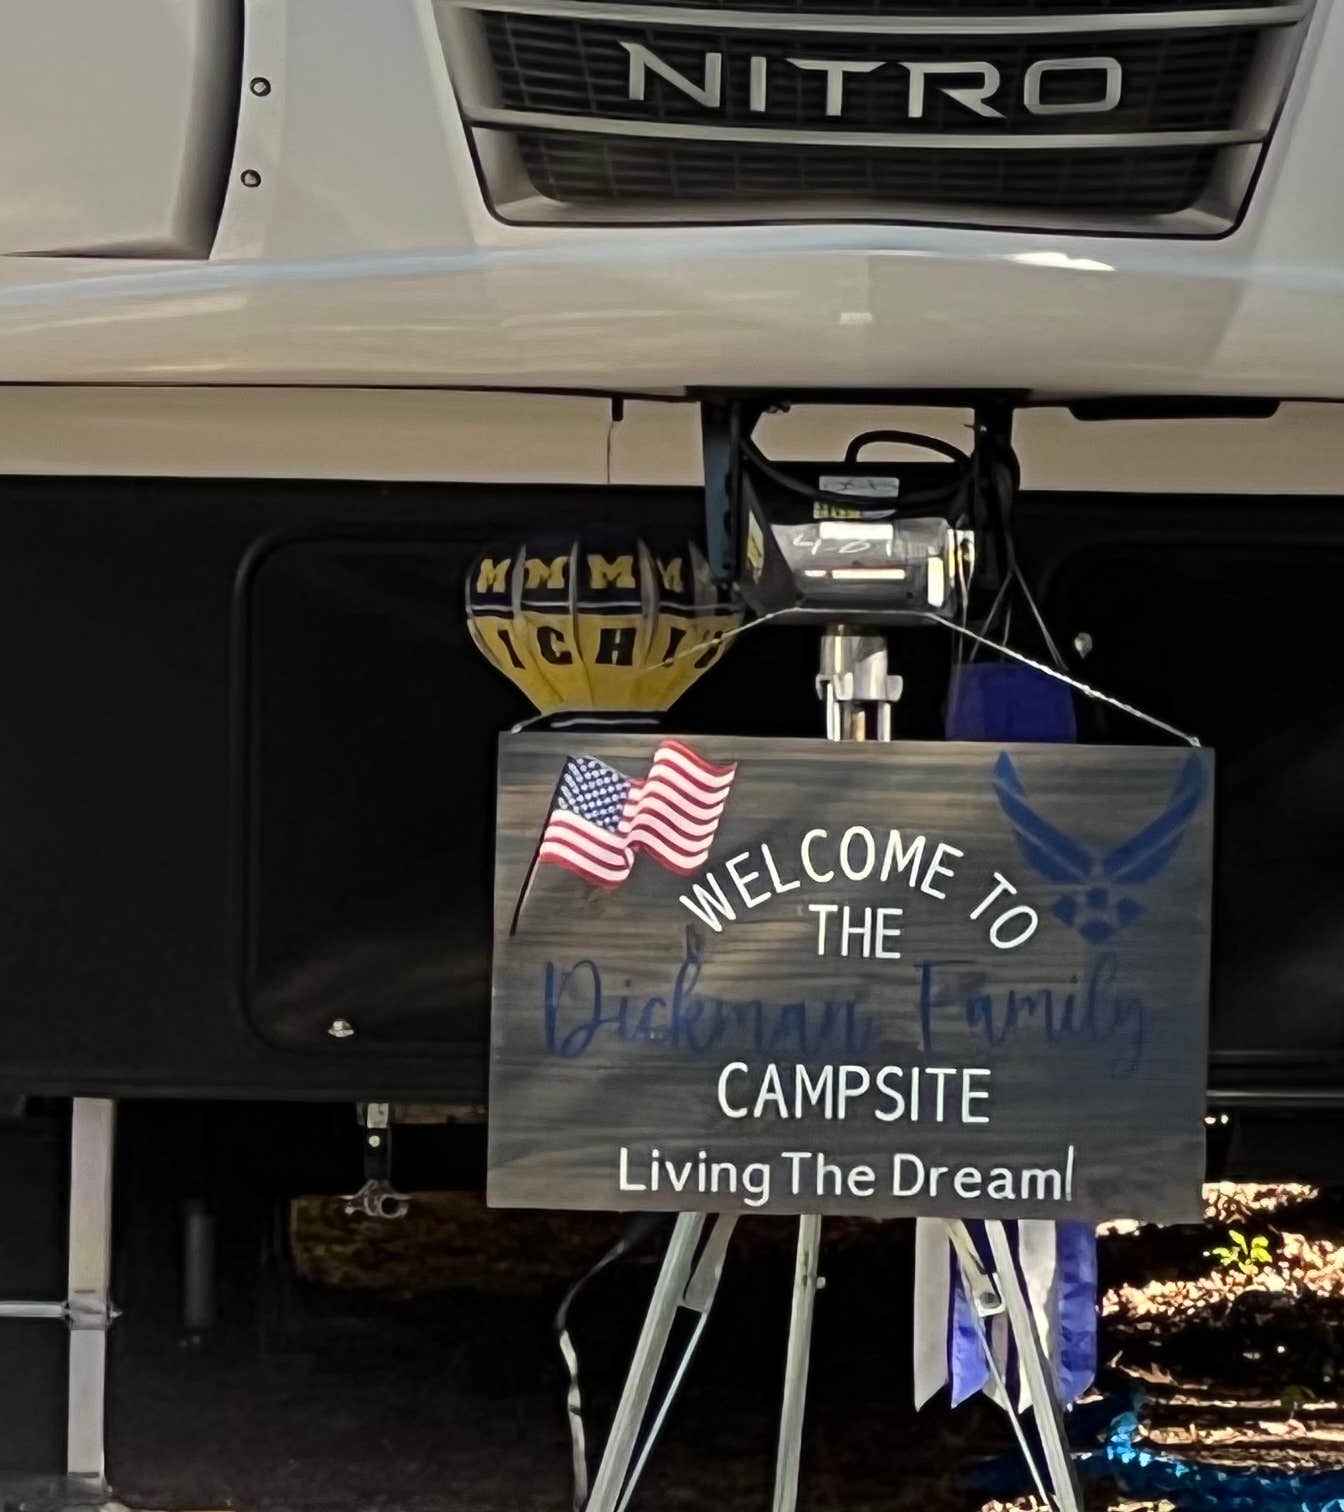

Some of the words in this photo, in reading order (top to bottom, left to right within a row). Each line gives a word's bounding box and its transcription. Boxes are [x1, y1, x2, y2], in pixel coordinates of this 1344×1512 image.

[618, 41, 1123, 119] NITRO
[679, 826, 964, 933] WELCOME
[970, 872, 1039, 949] TO
[808, 904, 903, 959] THE
[544, 924, 878, 1058] Dickman
[914, 951, 1146, 1080] Family
[717, 1062, 992, 1123] CAMPSITE
[619, 1148, 771, 1207] Living
[781, 1151, 876, 1196] The
